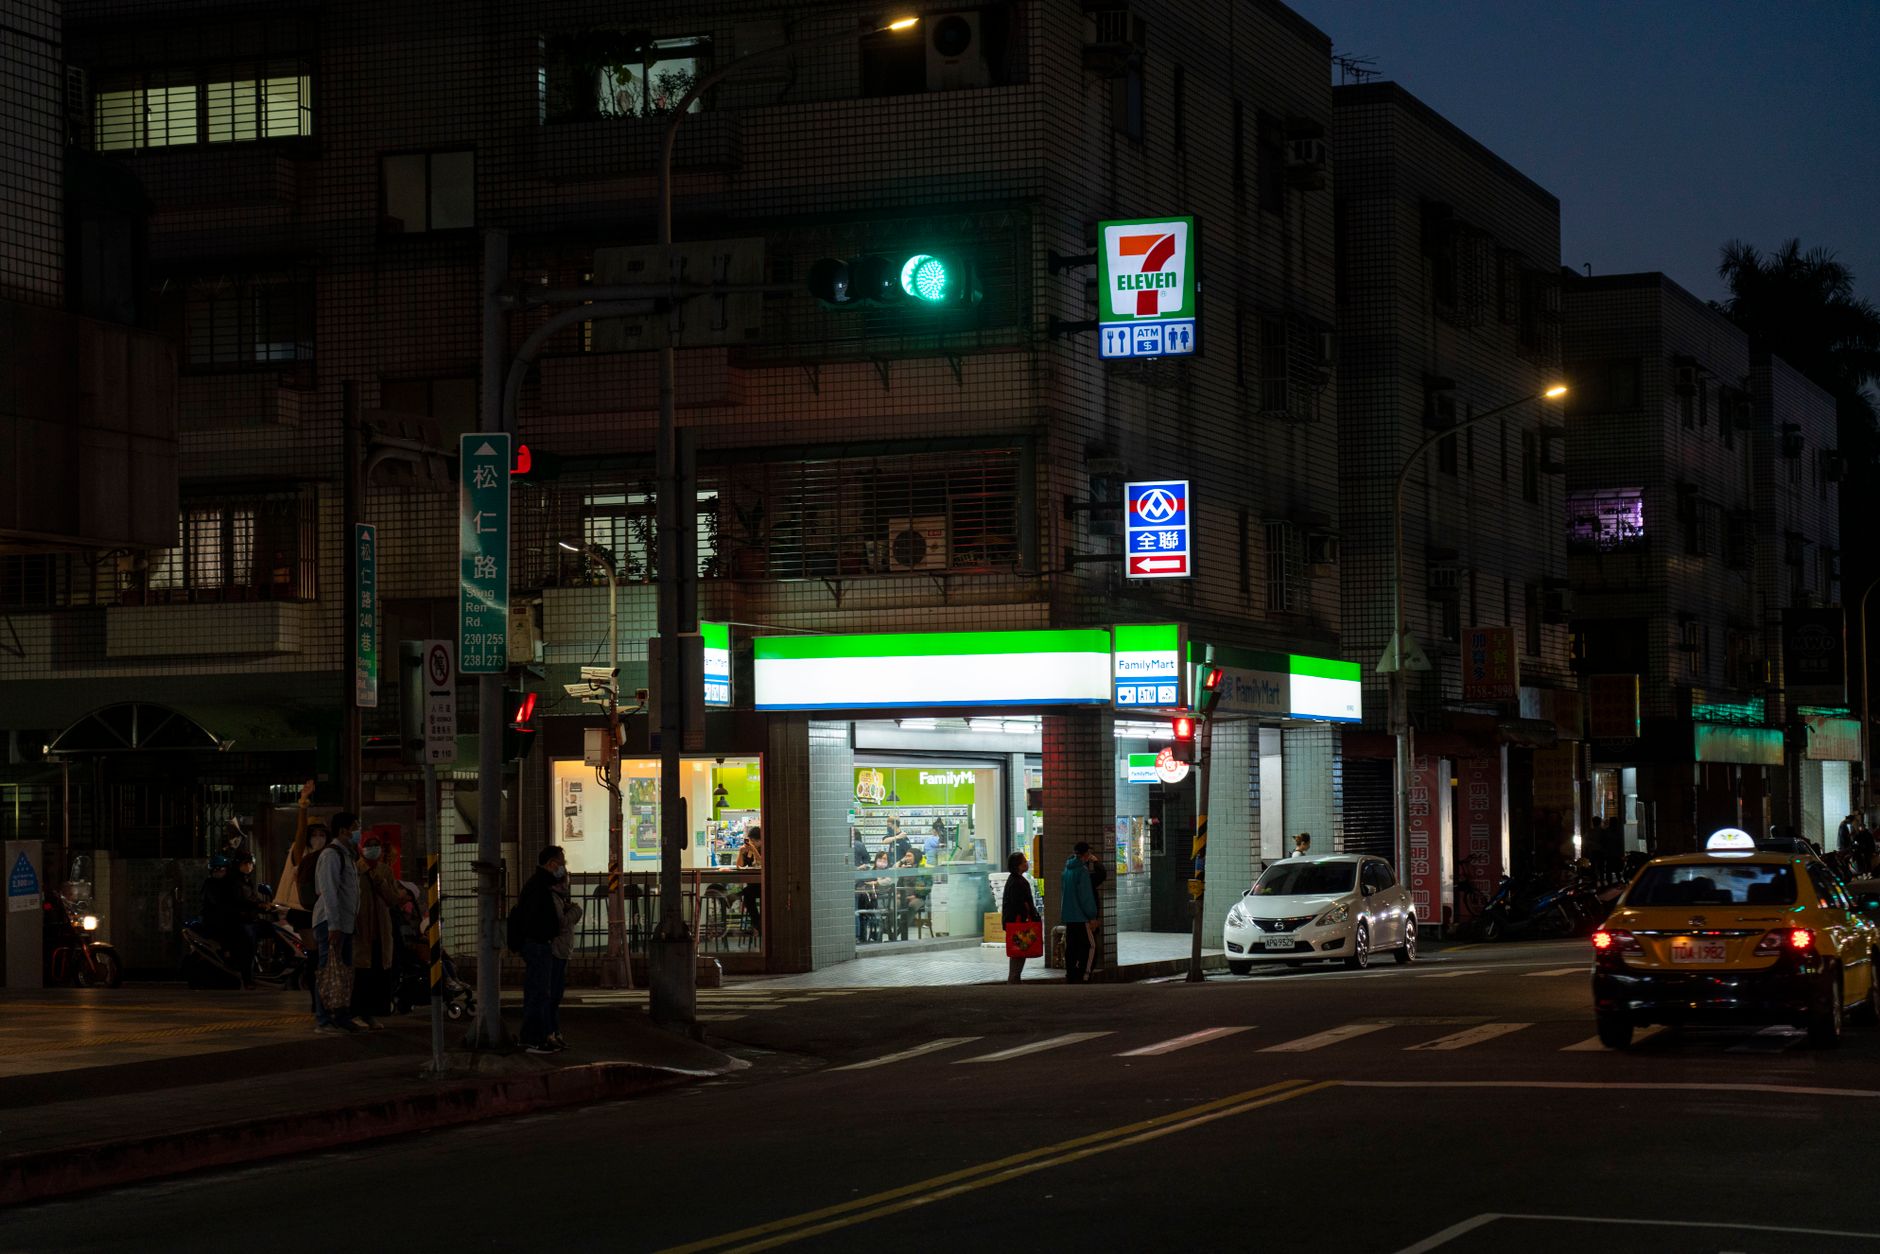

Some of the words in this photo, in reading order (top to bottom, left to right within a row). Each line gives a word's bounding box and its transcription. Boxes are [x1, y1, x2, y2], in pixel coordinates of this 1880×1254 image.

[1137, 328, 1159, 337] ATM
[473, 464, 498, 579] 松仁路
[1136, 531, 1179, 550] 全聯
[465, 602, 487, 612] Ren
[465, 616, 483, 627] Rd.
[464, 633, 481, 645] 230
[487, 633, 504, 645] 255
[464, 655, 481, 666] 238
[486, 655, 504, 666] 273
[1119, 659, 1174, 671] FamilyMart
[1140, 688, 1154, 701] ATM
[1236, 677, 1280, 705] FamilyMart
